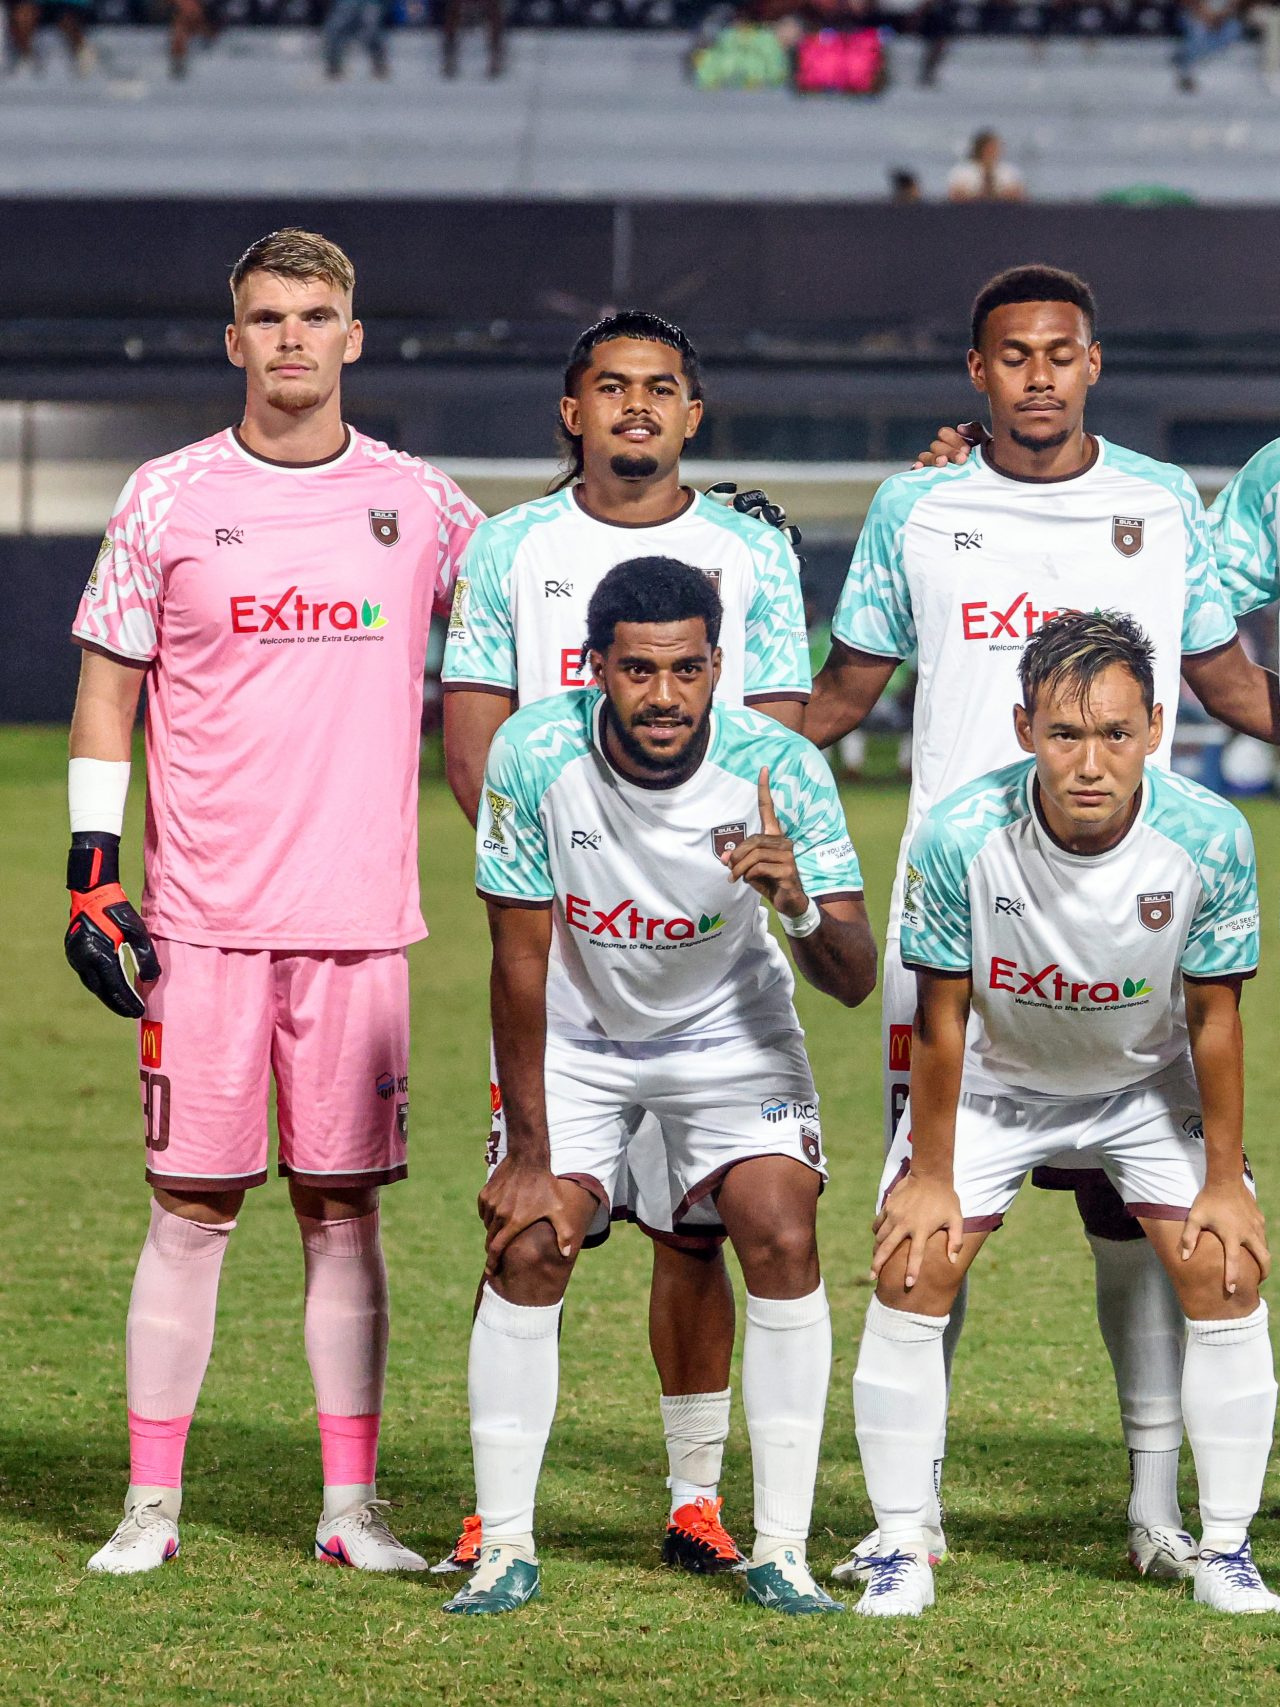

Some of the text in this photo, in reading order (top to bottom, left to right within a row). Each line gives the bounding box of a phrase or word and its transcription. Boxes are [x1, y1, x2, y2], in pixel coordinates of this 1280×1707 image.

[230, 586, 358, 634] Extra
[962, 592, 1082, 640] Extr
[259, 637, 295, 646] Welcome
[321, 635, 342, 643] Extra
[343, 634, 385, 644] Experience
[989, 644, 1025, 652] Welcome
[483, 840, 509, 855] OFC
[566, 893, 695, 941] Extra
[589, 938, 627, 950] Welcome
[629, 941, 638, 950] to
[640, 940, 653, 950] the
[989, 956, 1120, 1003] Extra
[1015, 998, 1053, 1009] Welcome
[1065, 1004, 1078, 1012] the
